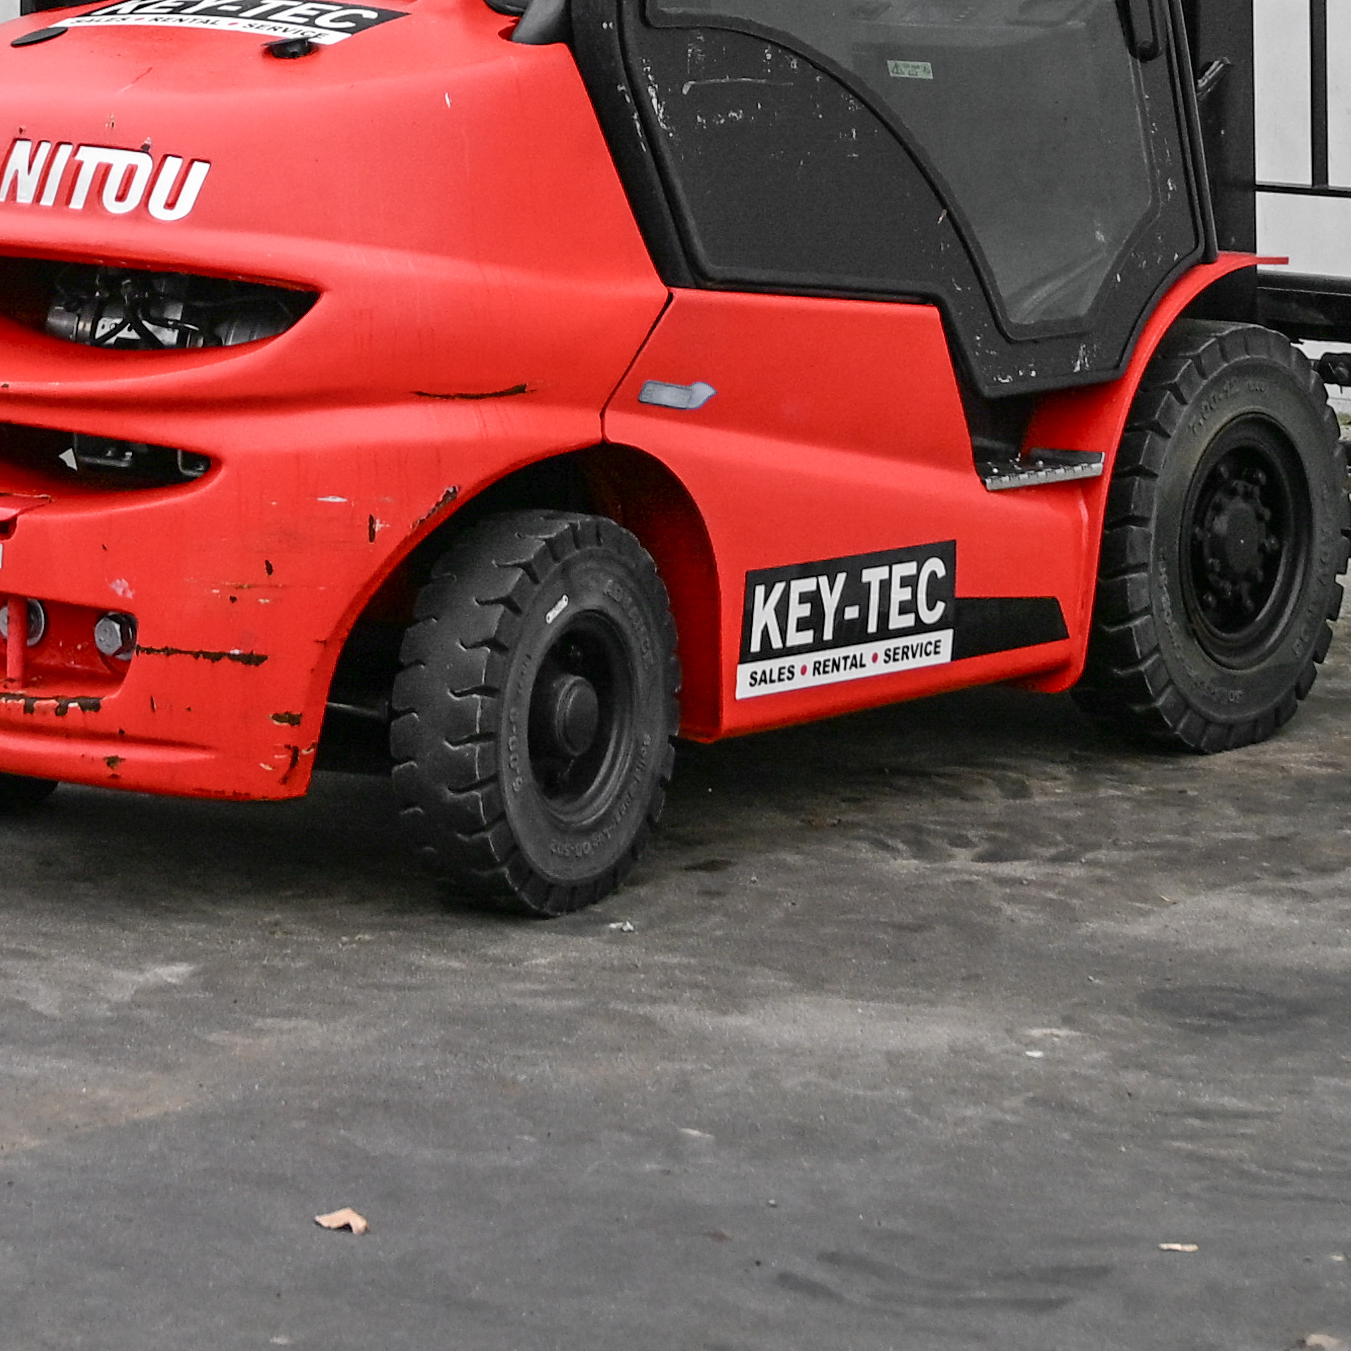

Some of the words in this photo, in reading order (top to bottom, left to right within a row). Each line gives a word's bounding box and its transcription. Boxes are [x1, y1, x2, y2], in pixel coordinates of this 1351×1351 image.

[73, 16, 128, 26] SALES
[149, 16, 221, 27] RENTAL
[241, 21, 327, 40] SERVICE
[750, 557, 946, 653] KEY-TEC
[747, 663, 796, 688] SALES
[812, 653, 867, 677] RENTAL
[882, 639, 942, 665] SERVICE
